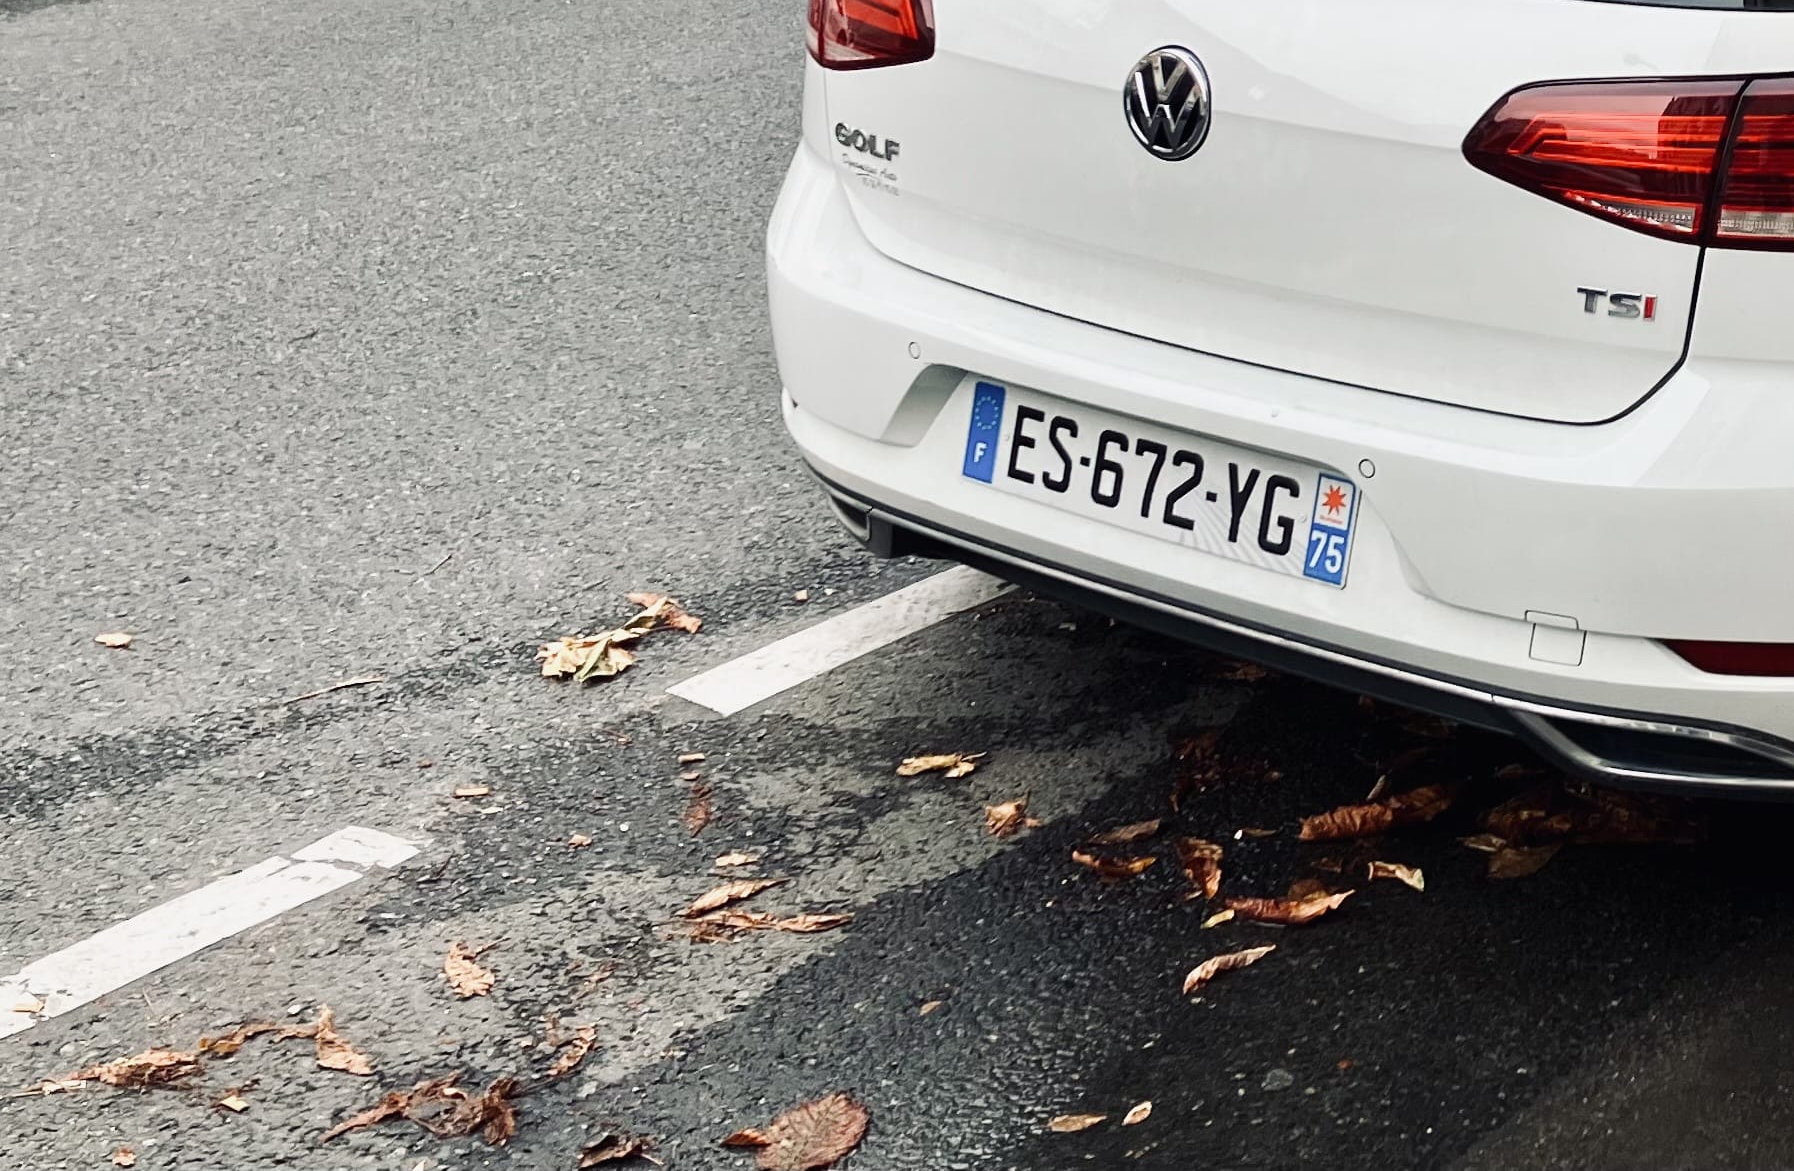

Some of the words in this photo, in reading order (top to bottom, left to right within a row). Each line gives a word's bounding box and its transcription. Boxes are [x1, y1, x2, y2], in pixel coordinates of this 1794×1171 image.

[835, 122, 900, 161] GOLF
[1577, 286, 1658, 321] TSI
[973, 442, 988, 463] F
[1007, 405, 1300, 556] ES-672-YG
[1309, 530, 1345, 574] 75
